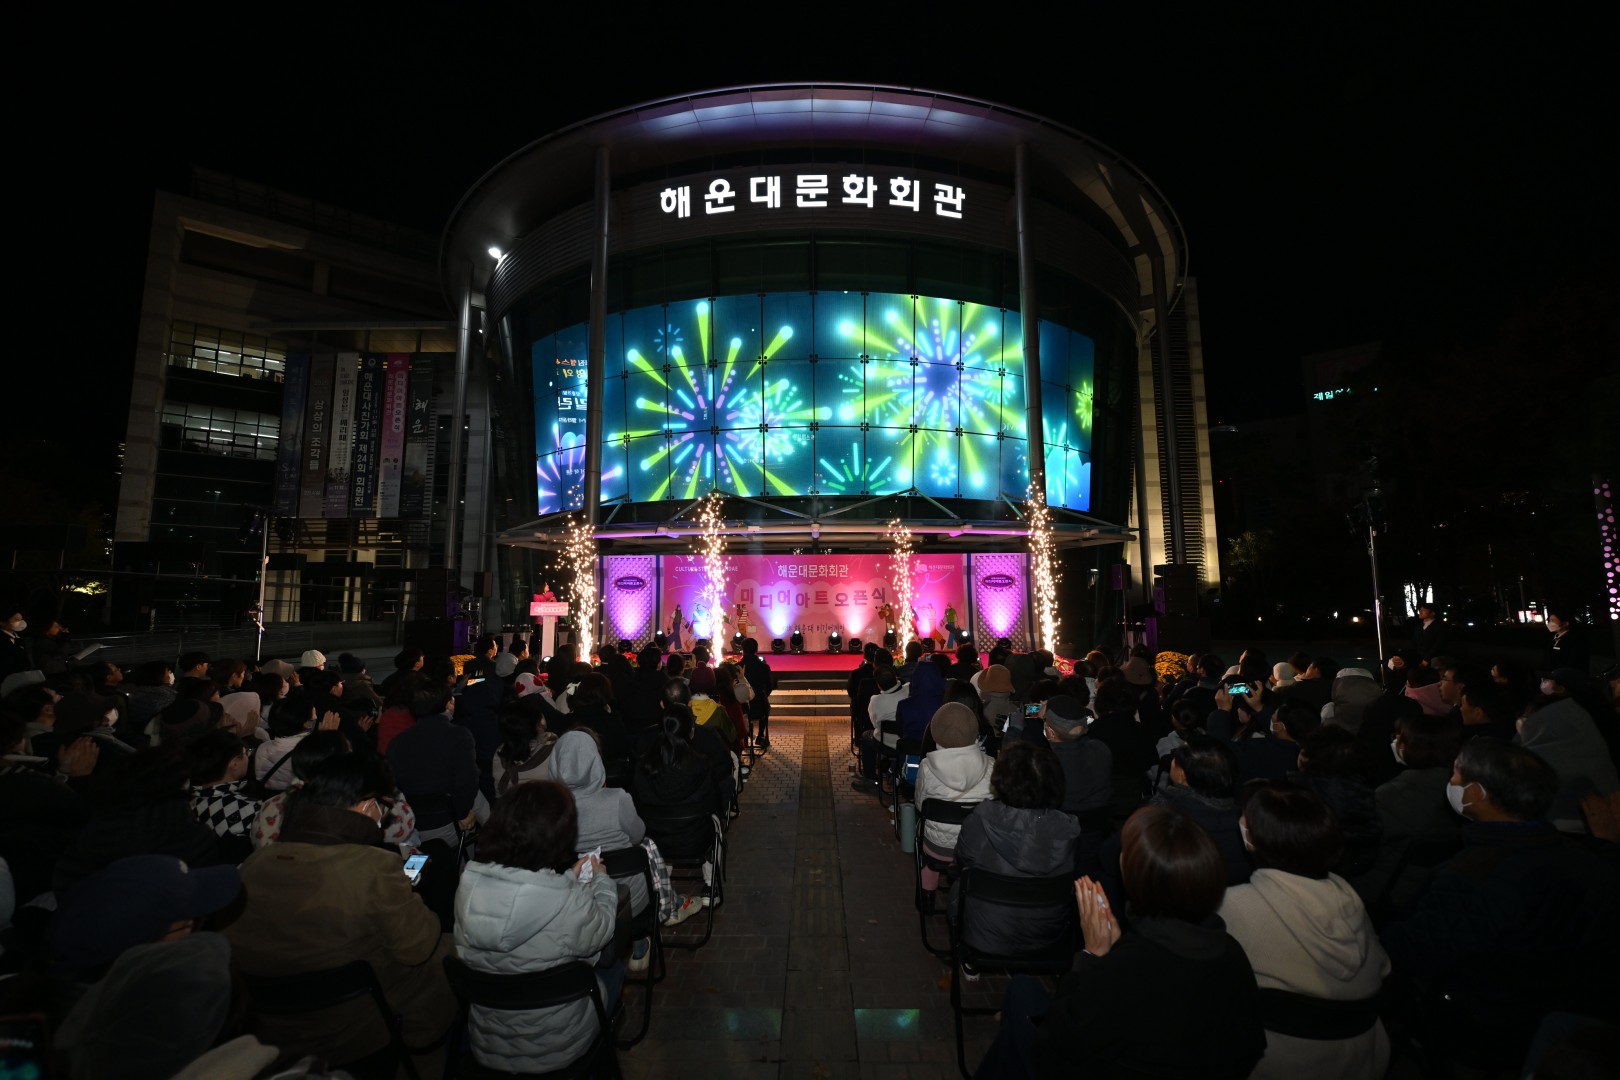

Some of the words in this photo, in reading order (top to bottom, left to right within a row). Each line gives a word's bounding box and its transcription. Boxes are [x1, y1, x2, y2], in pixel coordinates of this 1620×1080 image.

[659, 173, 966, 219] 해운대문화회관
[311, 400, 325, 433] 상상의
[359, 372, 373, 441] 해운대사진가회
[309, 436, 321, 471] 조각들
[356, 444, 368, 473] 제24회
[354, 476, 366, 507] 회원전
[777, 564, 849, 578] 해운대문화회관
